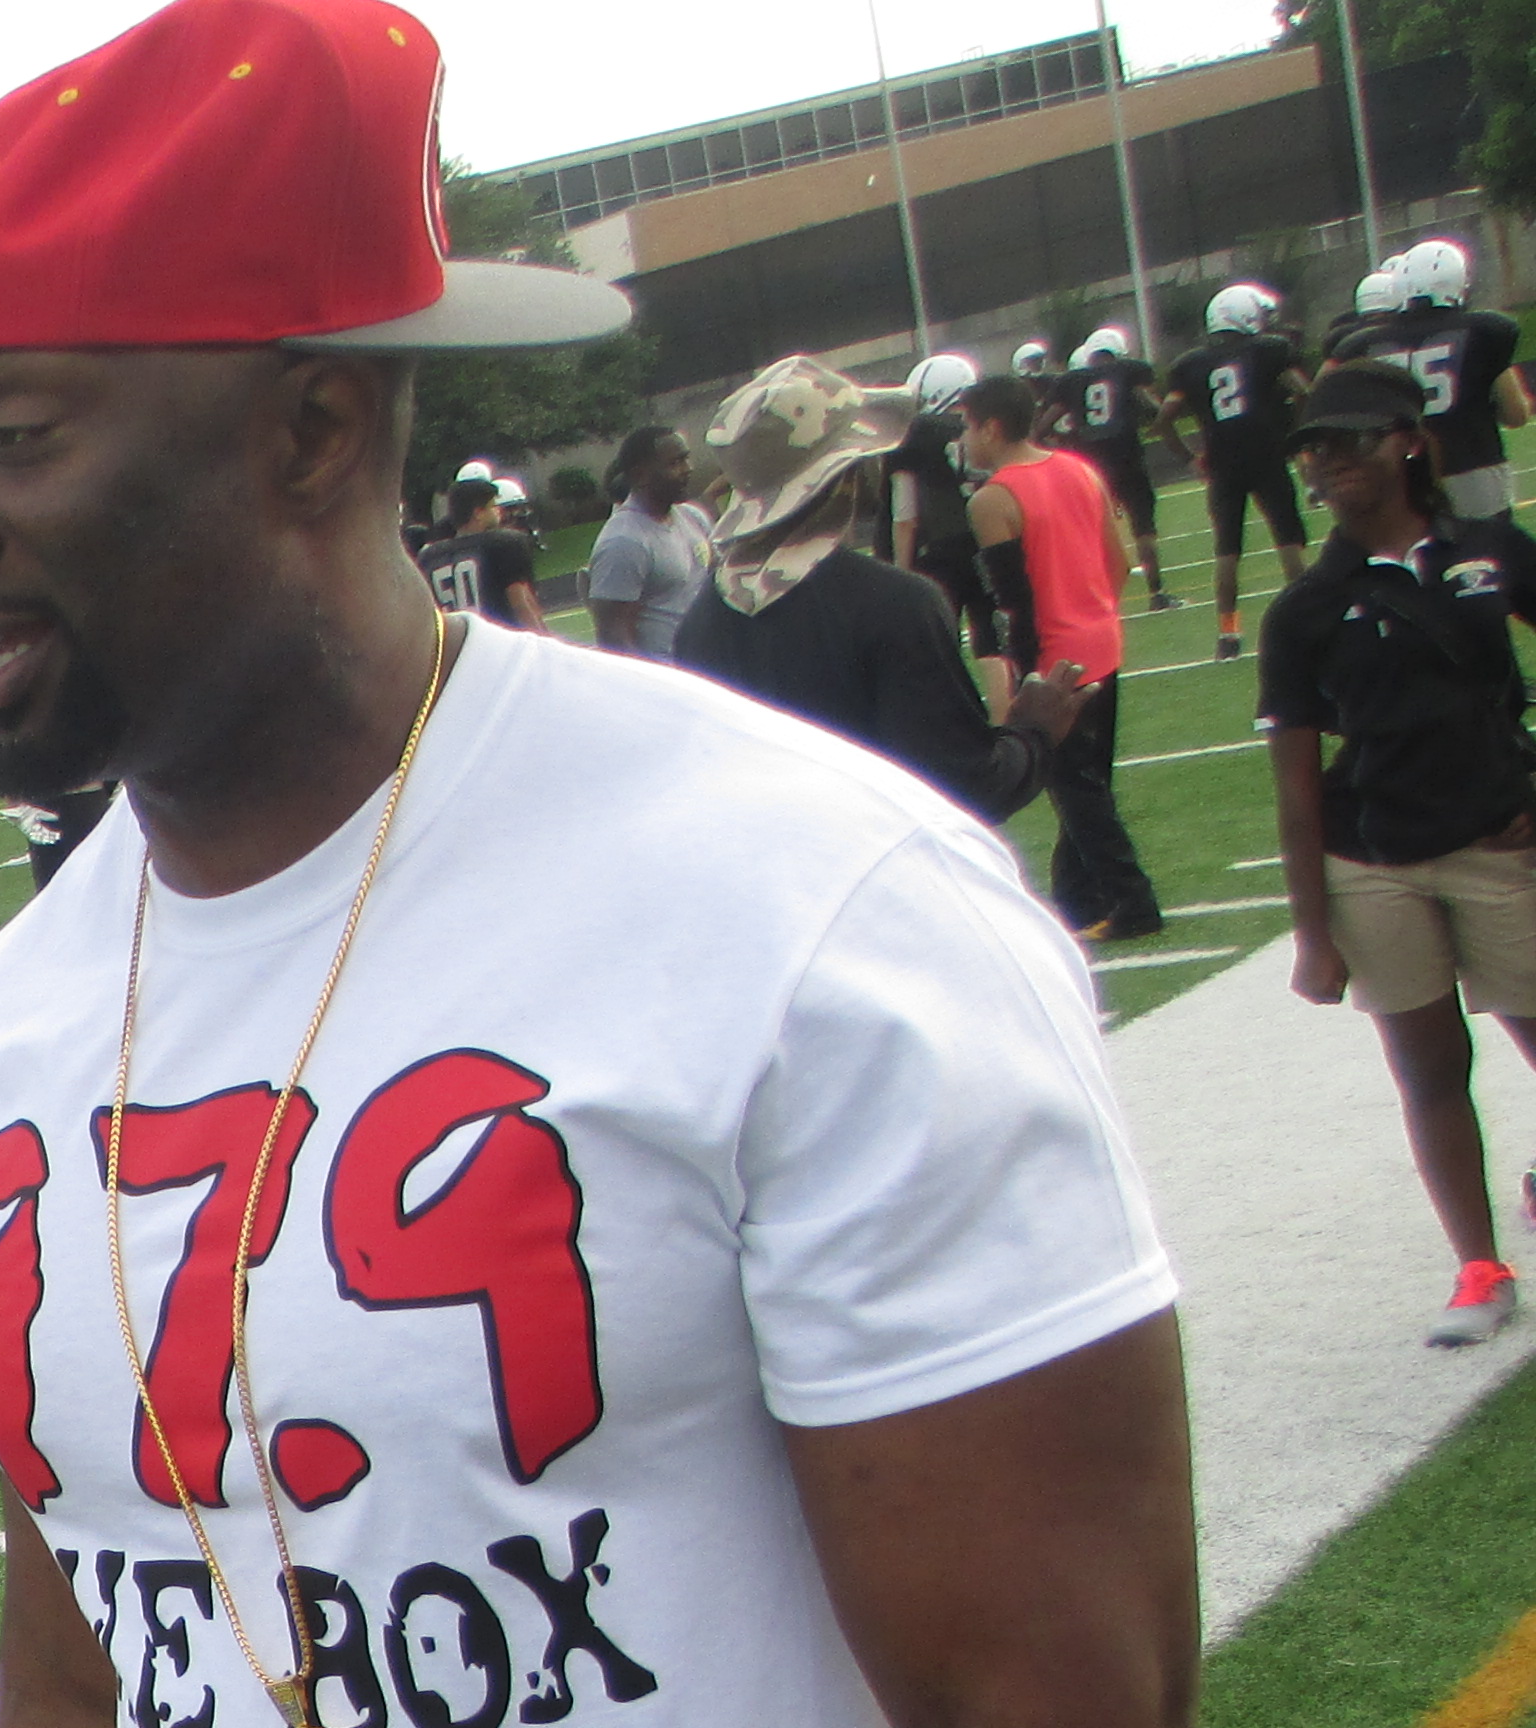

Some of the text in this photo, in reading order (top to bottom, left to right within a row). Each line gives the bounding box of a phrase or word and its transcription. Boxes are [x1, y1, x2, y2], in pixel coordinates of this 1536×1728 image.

[1085, 382, 1111, 427] 9
[1209, 364, 1245, 423] 2
[1374, 343, 1453, 417] 5
